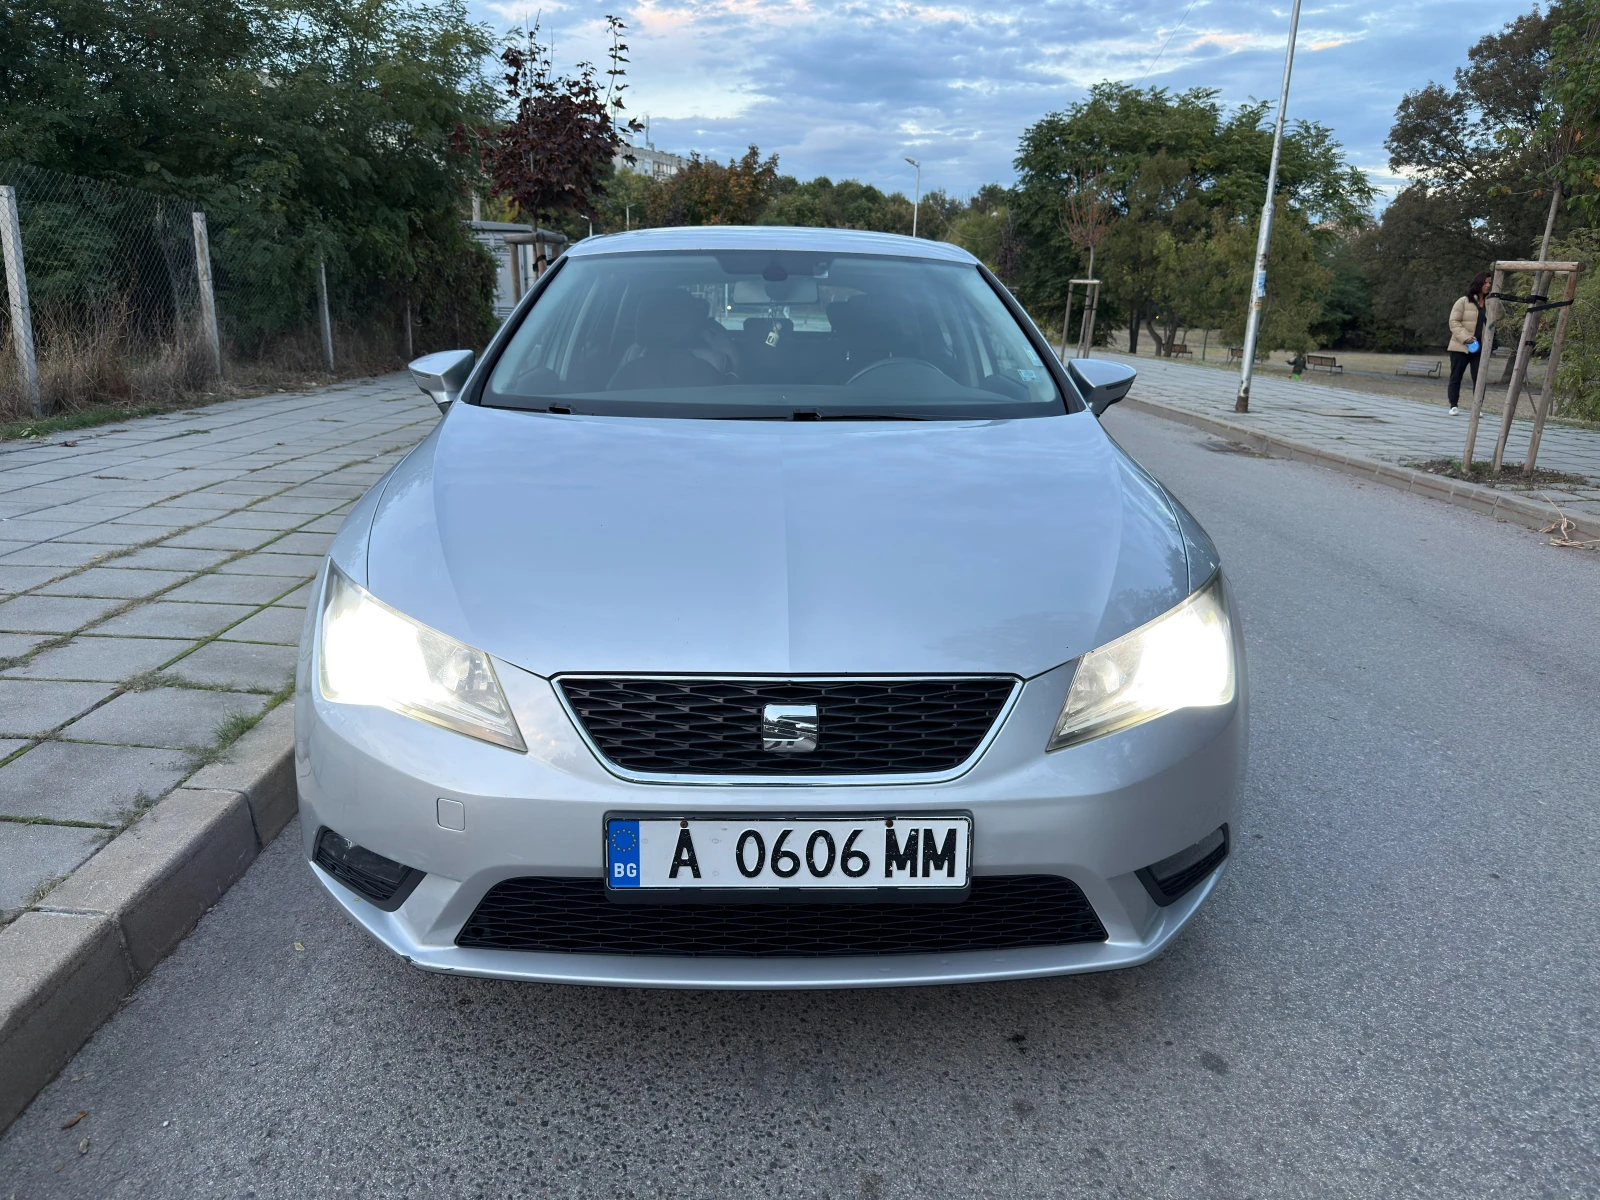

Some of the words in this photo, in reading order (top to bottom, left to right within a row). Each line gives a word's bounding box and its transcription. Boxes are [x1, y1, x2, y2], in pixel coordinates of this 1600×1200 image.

[668, 828, 702, 879] A
[735, 829, 870, 878] 0606
[884, 828, 957, 878] MM
[614, 863, 637, 878] BG
